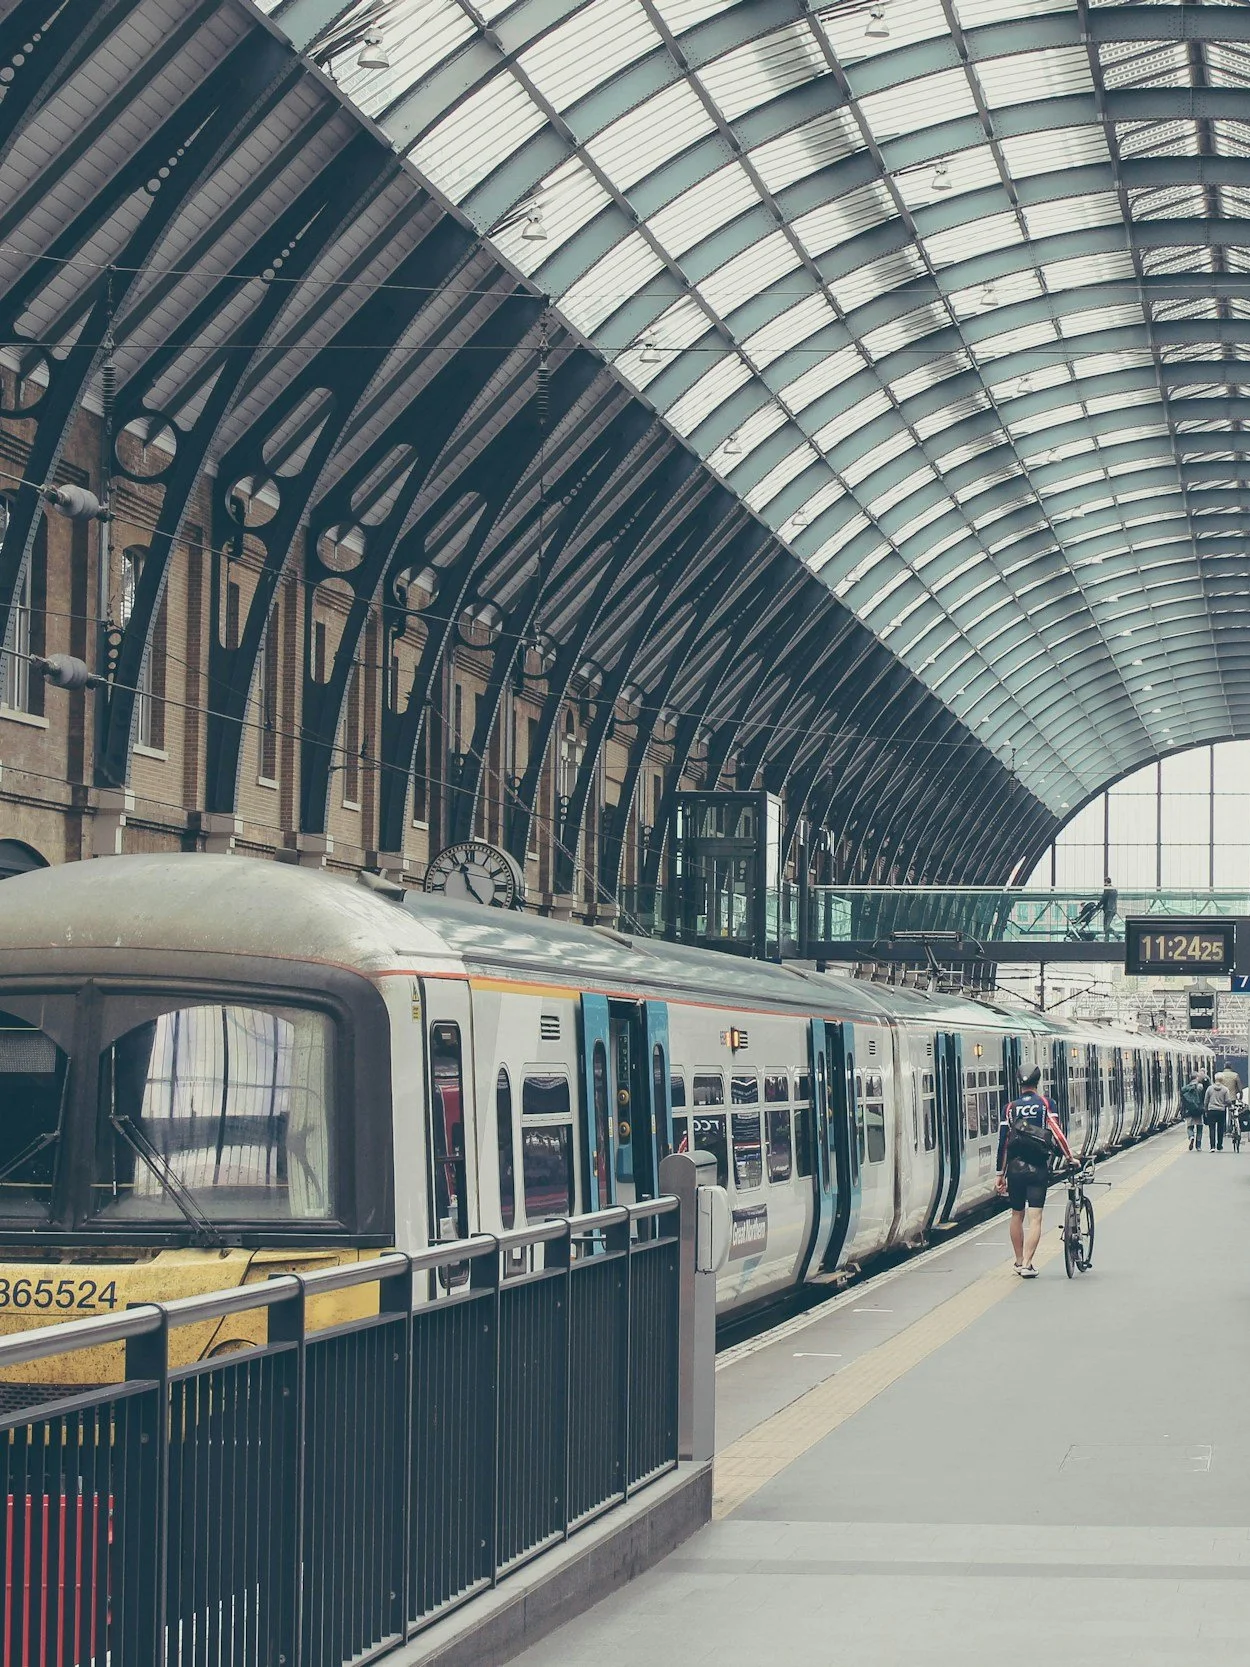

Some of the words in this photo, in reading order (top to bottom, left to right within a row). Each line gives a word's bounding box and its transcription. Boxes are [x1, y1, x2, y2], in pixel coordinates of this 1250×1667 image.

[1240, 976, 1249, 987] 7
[1016, 1104, 1039, 1117] TCC
[732, 1221, 745, 1246] Great
